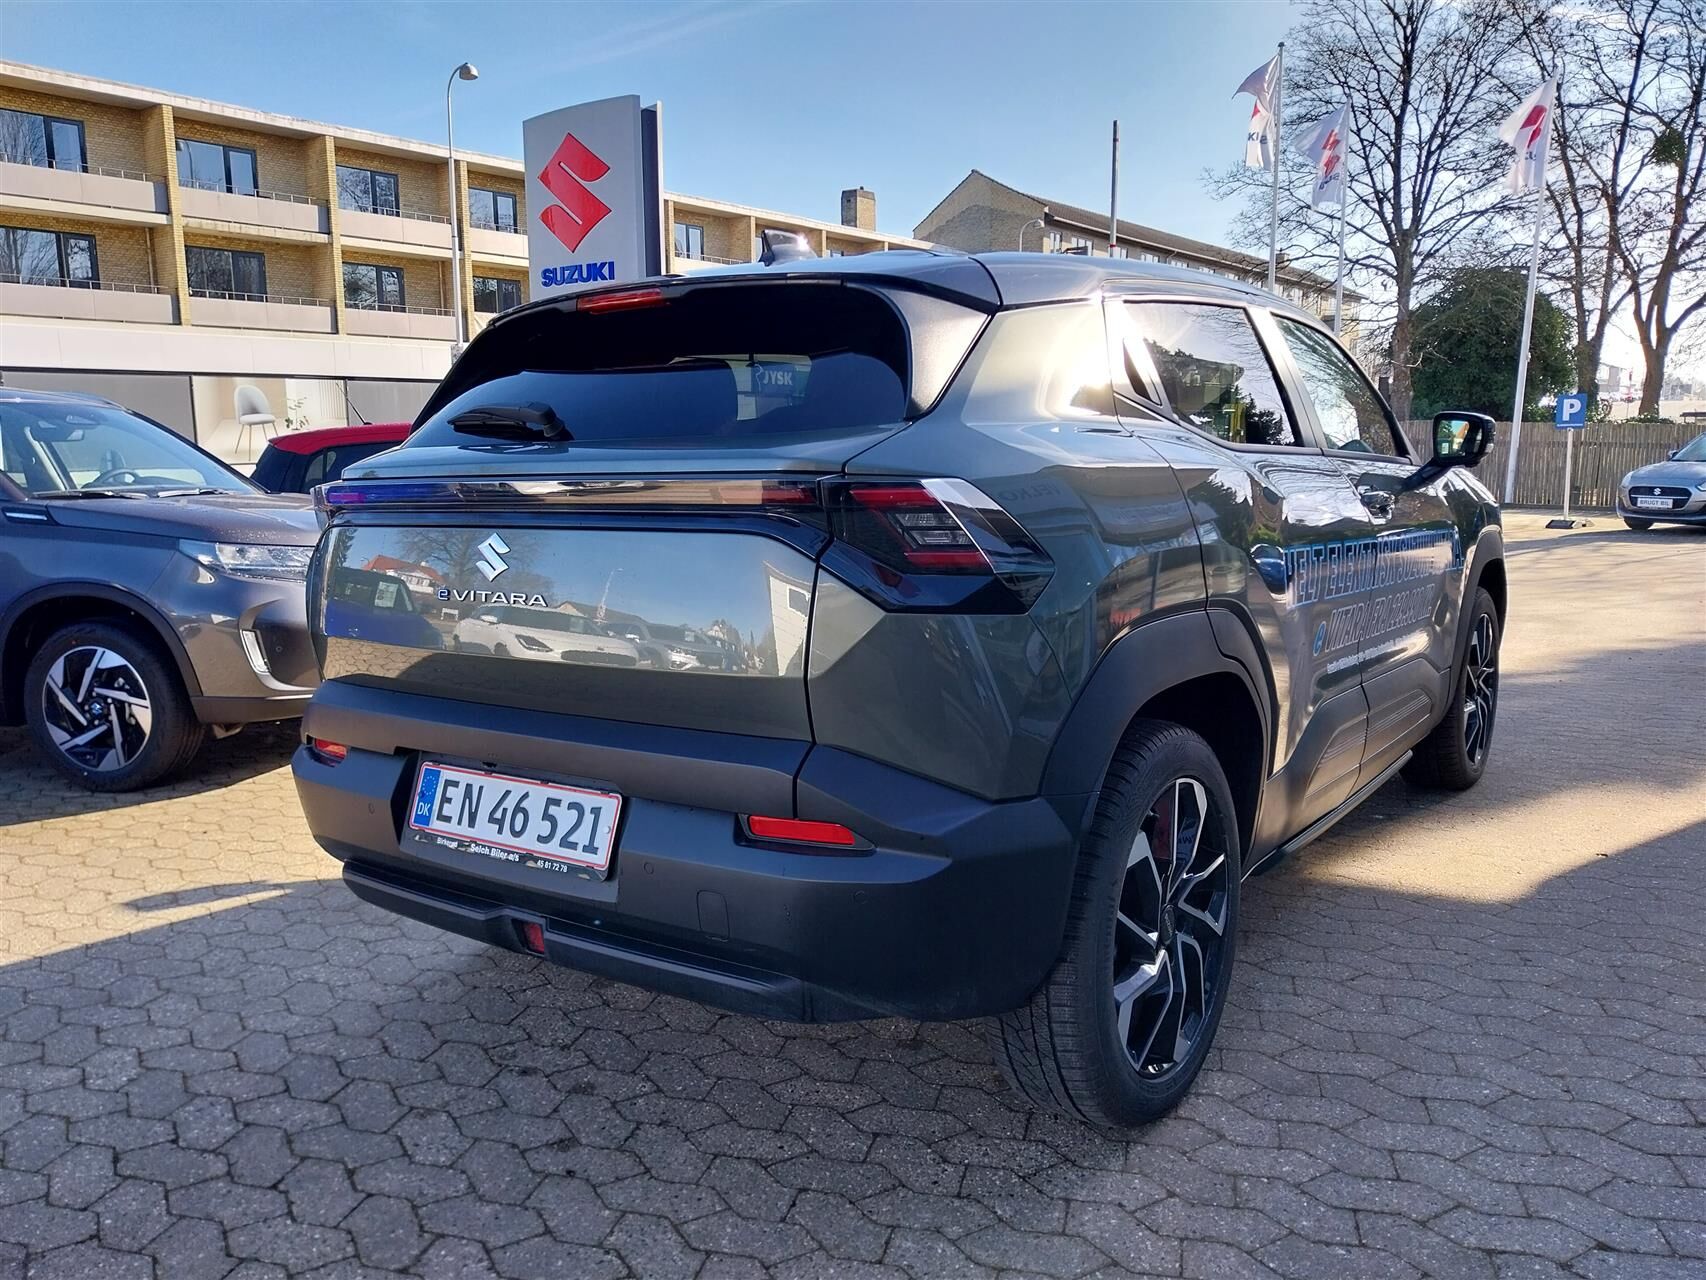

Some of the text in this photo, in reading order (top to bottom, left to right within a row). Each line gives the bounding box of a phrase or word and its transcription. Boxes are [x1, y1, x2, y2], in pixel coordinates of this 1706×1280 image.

[541, 261, 615, 287] SUZUKI
[763, 370, 793, 386] JYSK
[1562, 398, 1581, 421] P
[417, 802, 430, 816] DK
[436, 778, 603, 856] EN 46 521
[536, 859, 544, 868] 45
[545, 860, 551, 869] 81
[552, 862, 560, 871] 72
